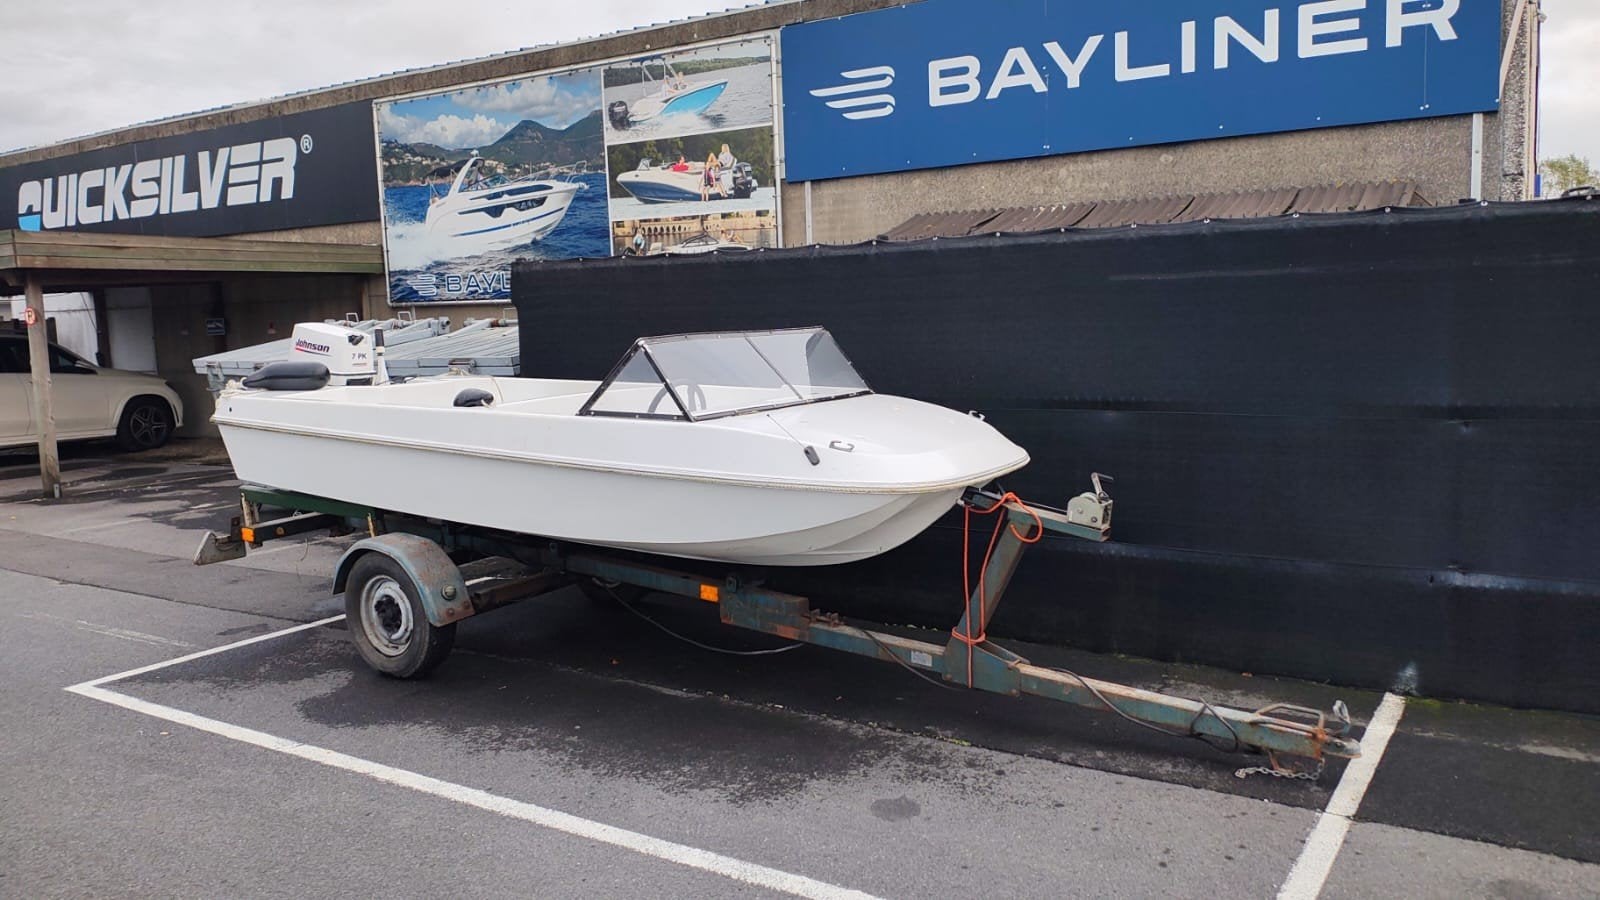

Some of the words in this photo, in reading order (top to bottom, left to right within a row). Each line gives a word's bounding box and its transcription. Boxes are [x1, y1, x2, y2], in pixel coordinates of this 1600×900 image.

[928, 0, 1459, 107] BAYLINER
[18, 137, 297, 232] QUICKSILVER
[296, 339, 330, 352] Johnson
